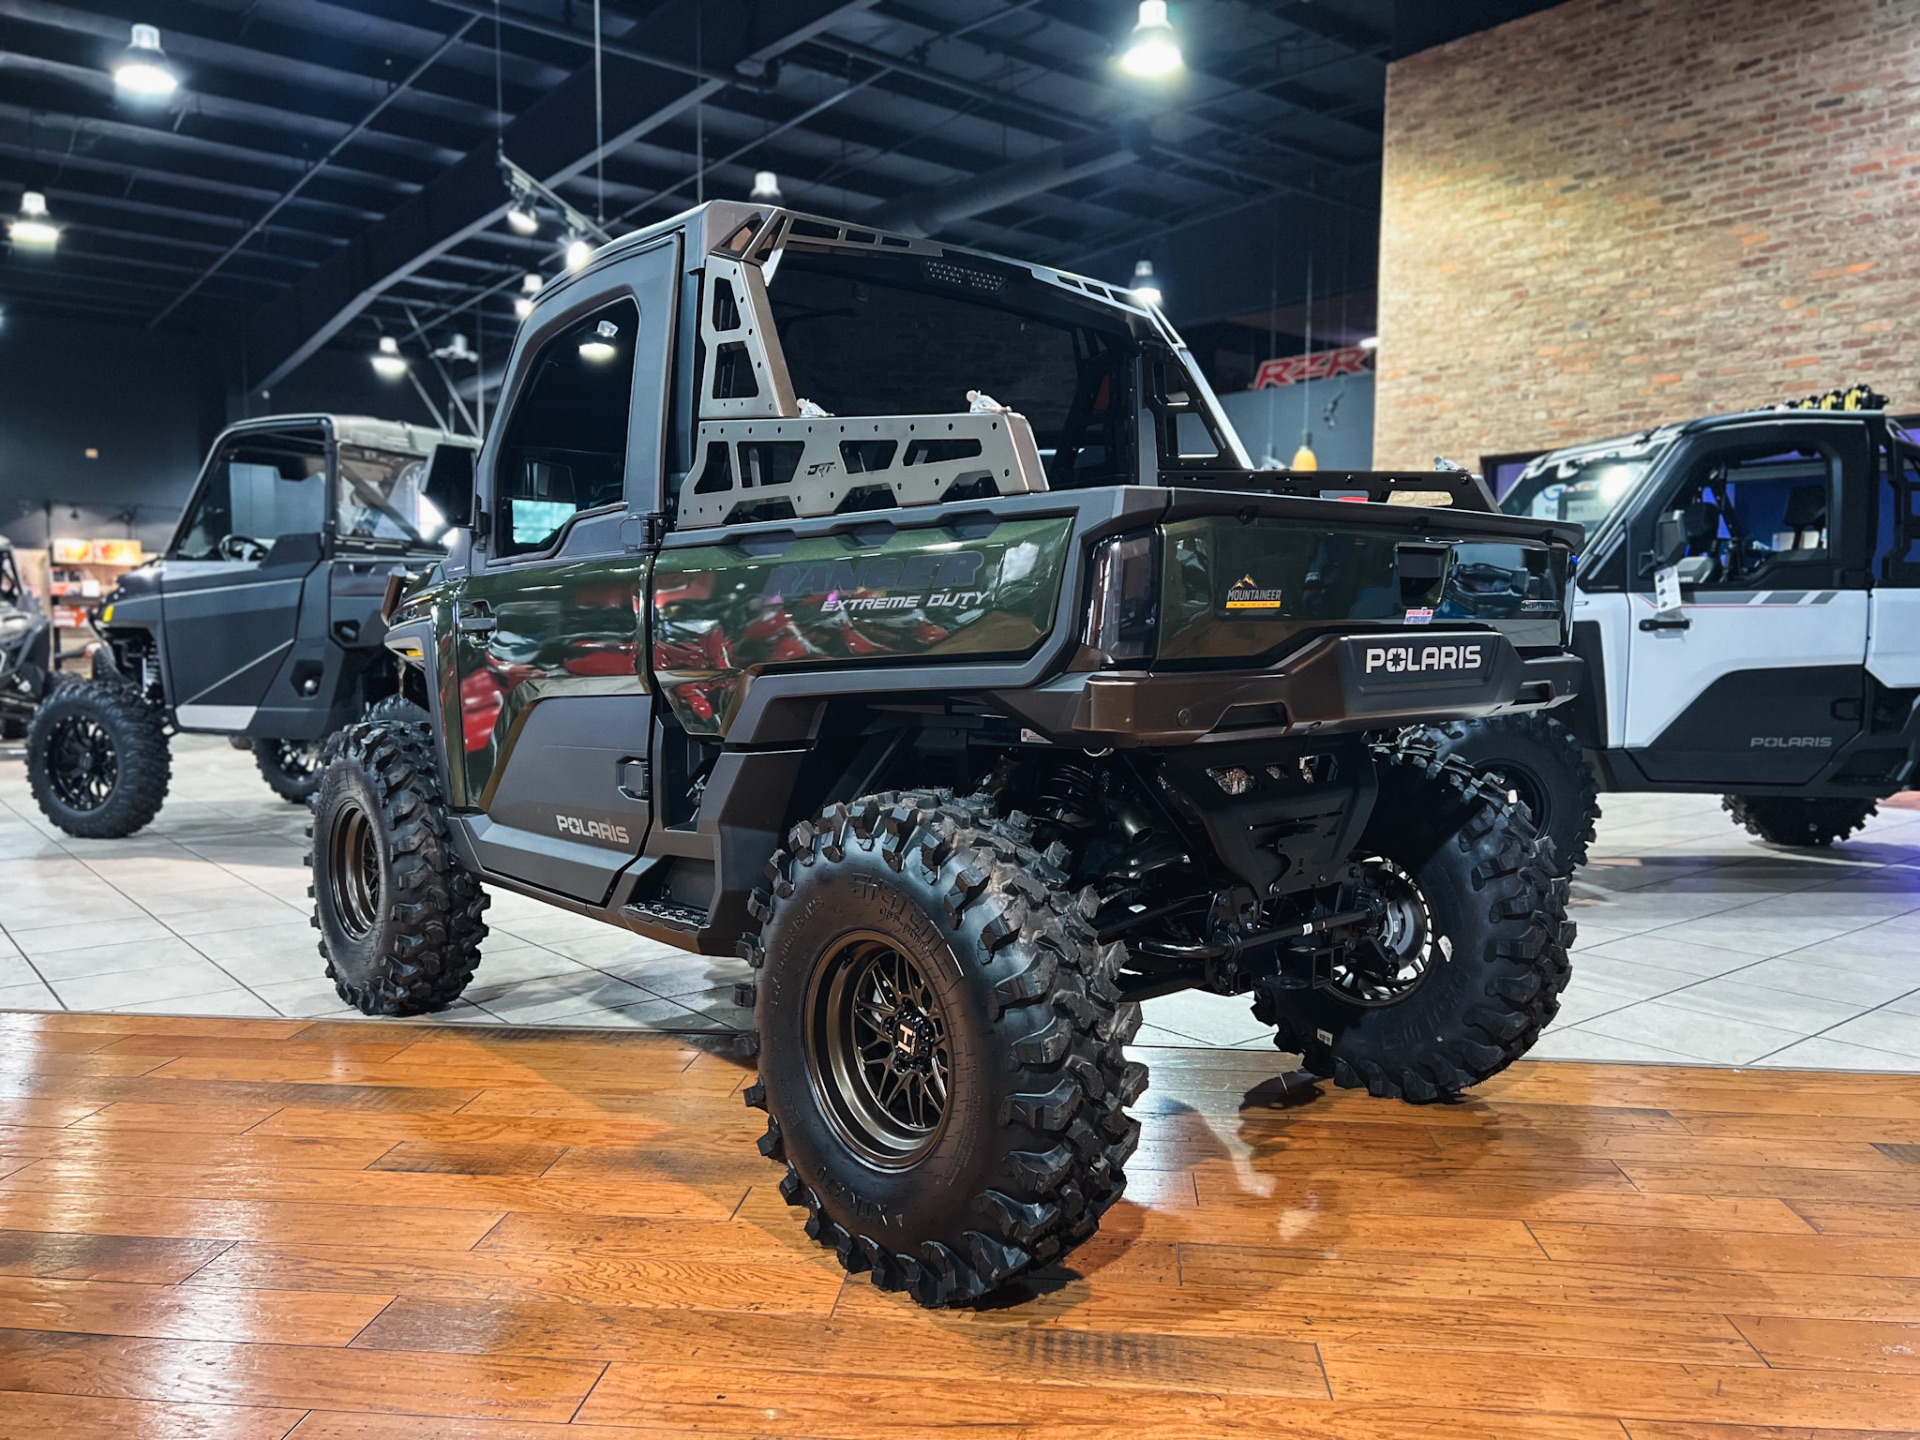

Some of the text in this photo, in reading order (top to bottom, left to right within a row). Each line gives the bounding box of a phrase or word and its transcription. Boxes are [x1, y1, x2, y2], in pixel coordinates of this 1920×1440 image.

[1254, 346, 1370, 391] RZR
[762, 550, 985, 597] RANGER
[820, 591, 991, 613] EXTREME DUTY
[1227, 589, 1282, 601] MOUNTAINEER
[1365, 645, 1482, 674] POLARIS
[1750, 736, 1833, 748] POLARIS
[556, 814, 630, 844] POLARIS
